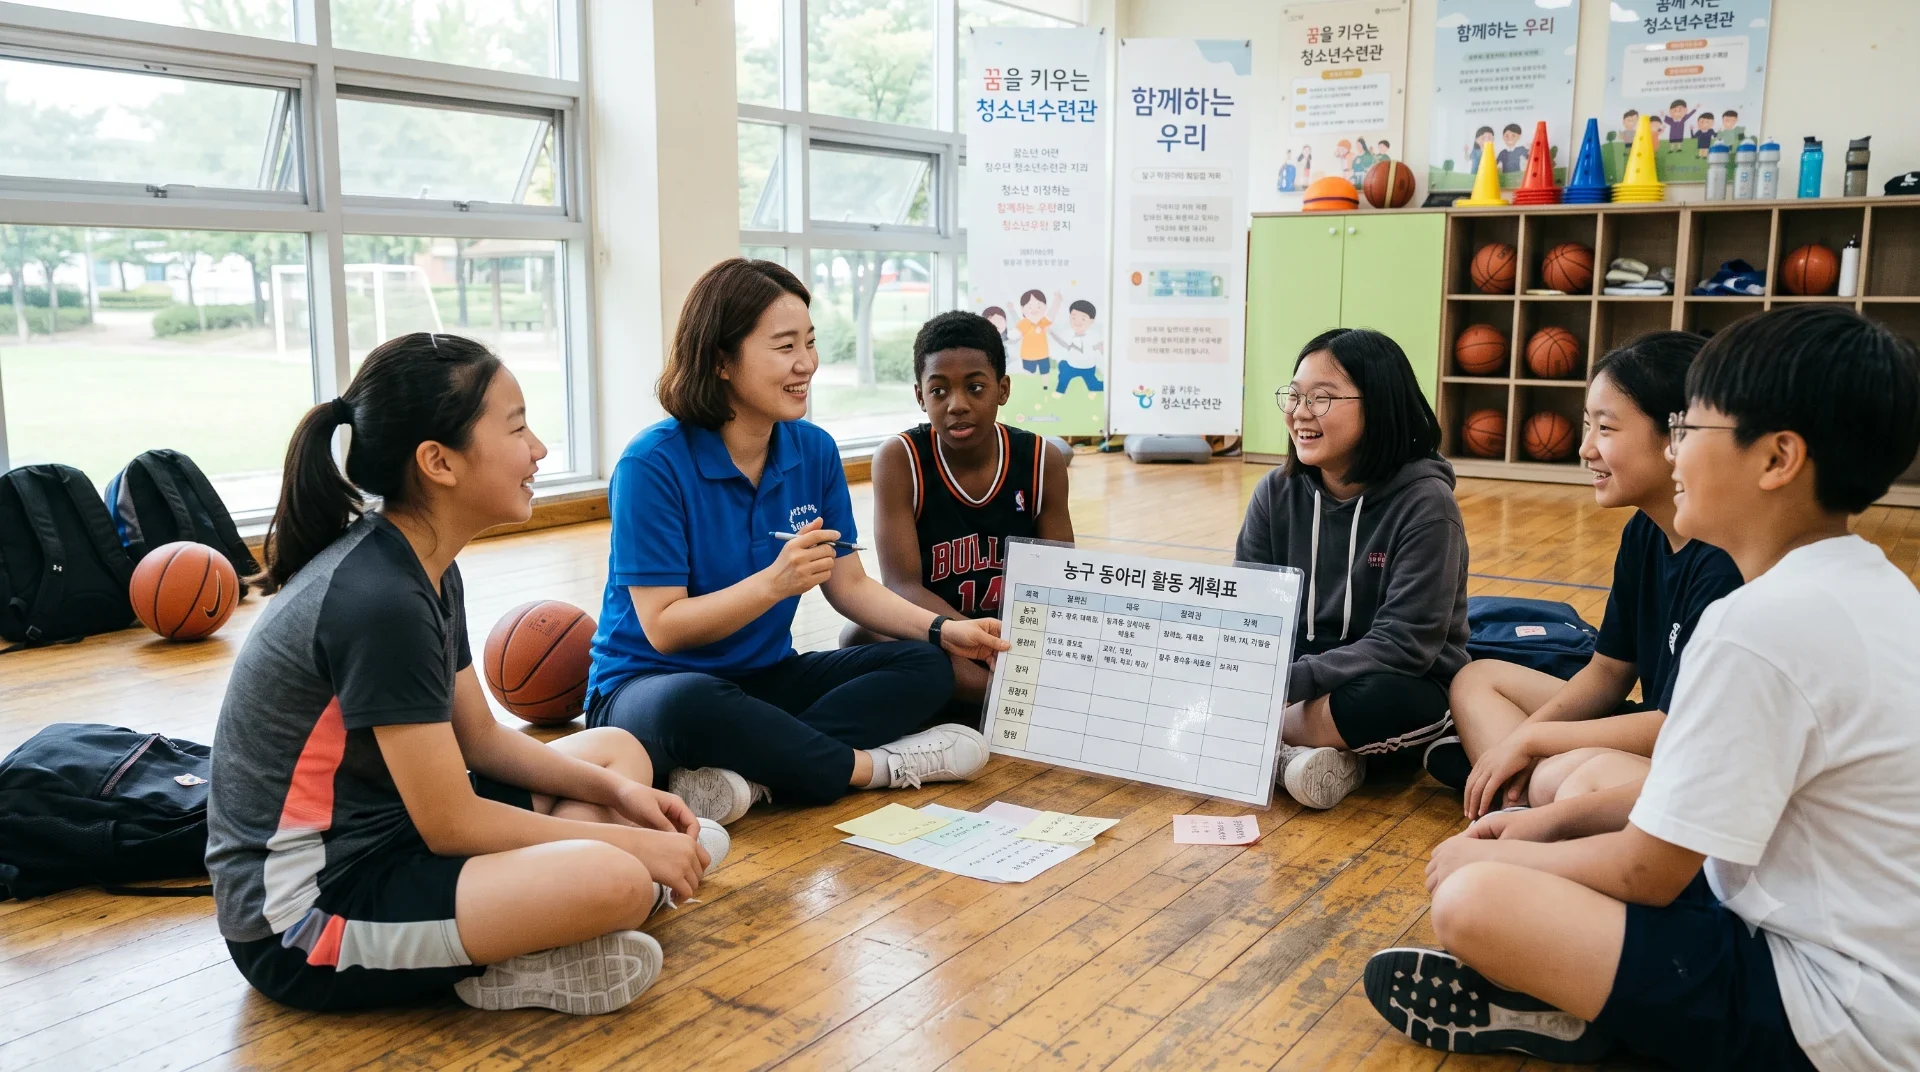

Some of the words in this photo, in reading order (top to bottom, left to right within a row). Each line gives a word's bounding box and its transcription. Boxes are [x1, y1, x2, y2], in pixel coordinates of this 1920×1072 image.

[1307, 26, 1334, 44] 꿈을
[1338, 23, 1379, 41] 키우는
[1457, 21, 1518, 43] 함께하는
[1523, 17, 1554, 36] 우리
[1644, 11, 1735, 34] 청소년수련관
[1300, 44, 1384, 66] 청소년수련관
[983, 67, 1023, 91] 꿈을
[1031, 69, 1090, 91] 키우는
[976, 98, 1098, 122] 청소년수련관
[1131, 86, 1235, 117] 함께하는
[1157, 124, 1206, 153] 우리
[1161, 397, 1222, 410] 청소년수련관
[931, 533, 1004, 582] BULL
[1063, 560, 1095, 582] 농구
[1099, 564, 1146, 588] 동아리
[1152, 570, 1184, 593] 활동
[1188, 575, 1238, 598] 계획표
[958, 575, 1004, 614] 14
